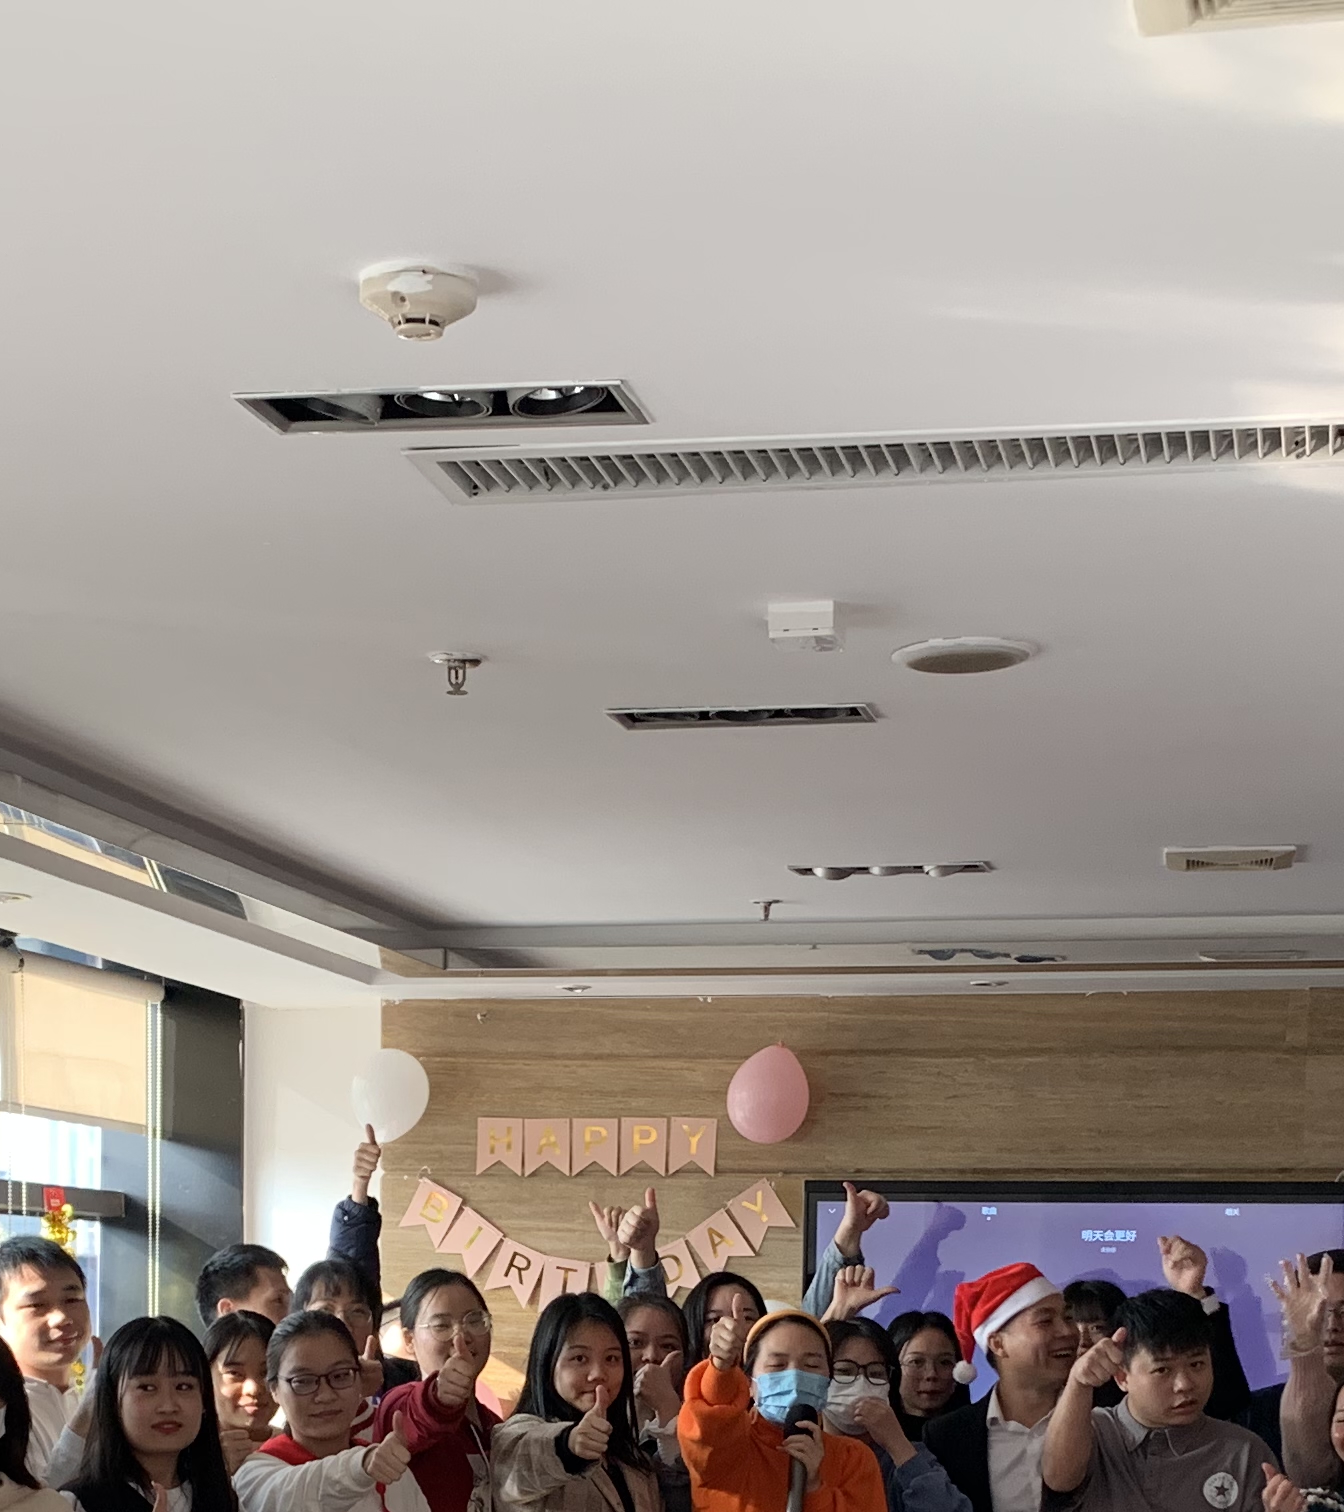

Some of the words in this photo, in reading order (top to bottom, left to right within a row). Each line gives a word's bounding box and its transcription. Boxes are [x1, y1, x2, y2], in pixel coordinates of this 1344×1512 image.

[488, 1125, 707, 1155] HAPPY
[419, 1190, 768, 1294] BIRTDAY
[1081, 1230, 1137, 1243] 明天会更好
